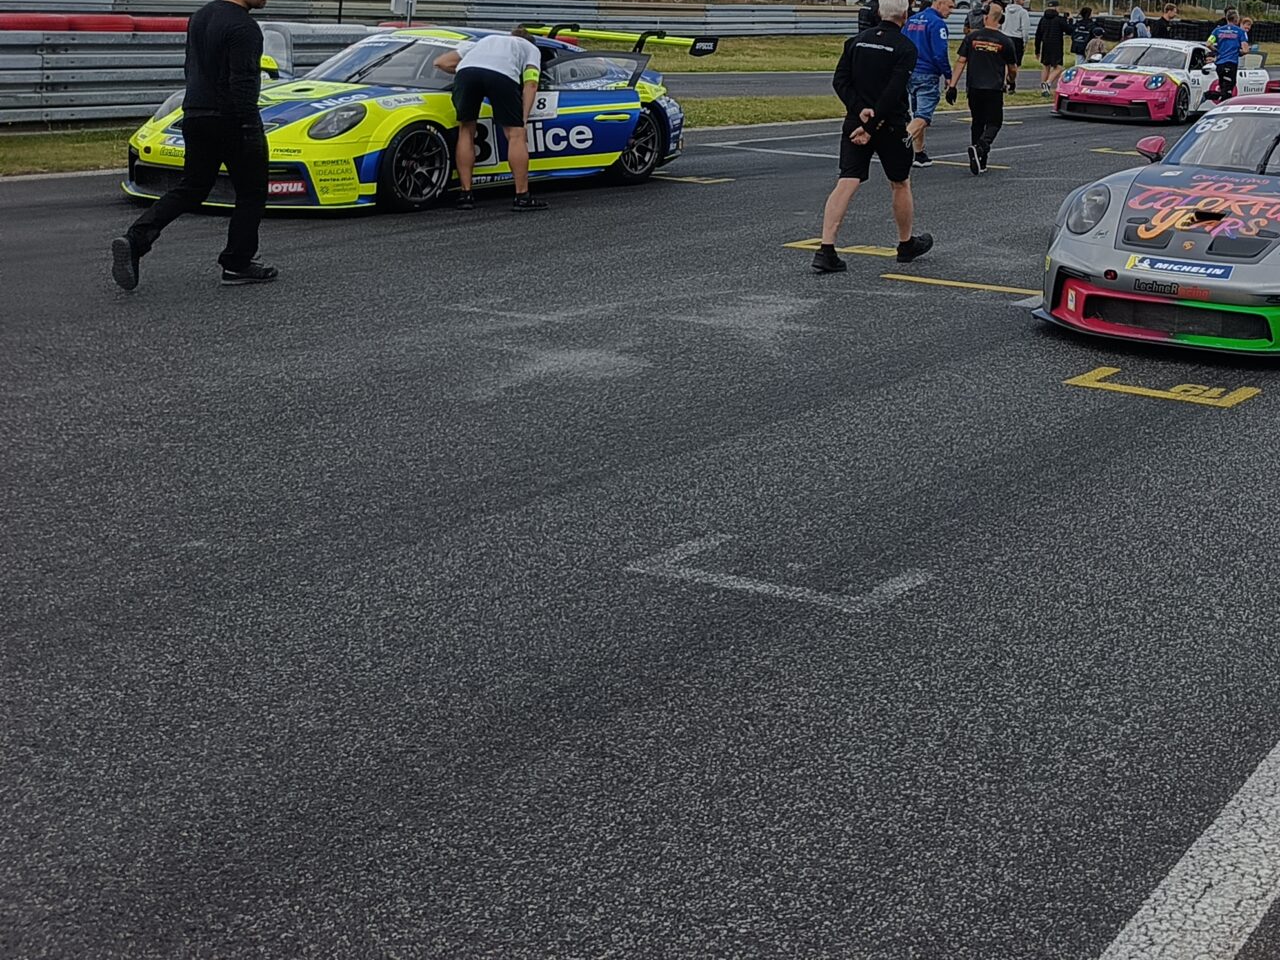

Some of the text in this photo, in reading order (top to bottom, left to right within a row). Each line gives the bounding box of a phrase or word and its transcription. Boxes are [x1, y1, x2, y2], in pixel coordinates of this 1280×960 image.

[940, 27, 948, 40] 8
[1191, 78, 1200, 86] 91
[311, 94, 369, 109] Nice
[536, 98, 547, 110] 8
[1195, 117, 1234, 133] 68
[1154, 262, 1225, 276] MICHELIN
